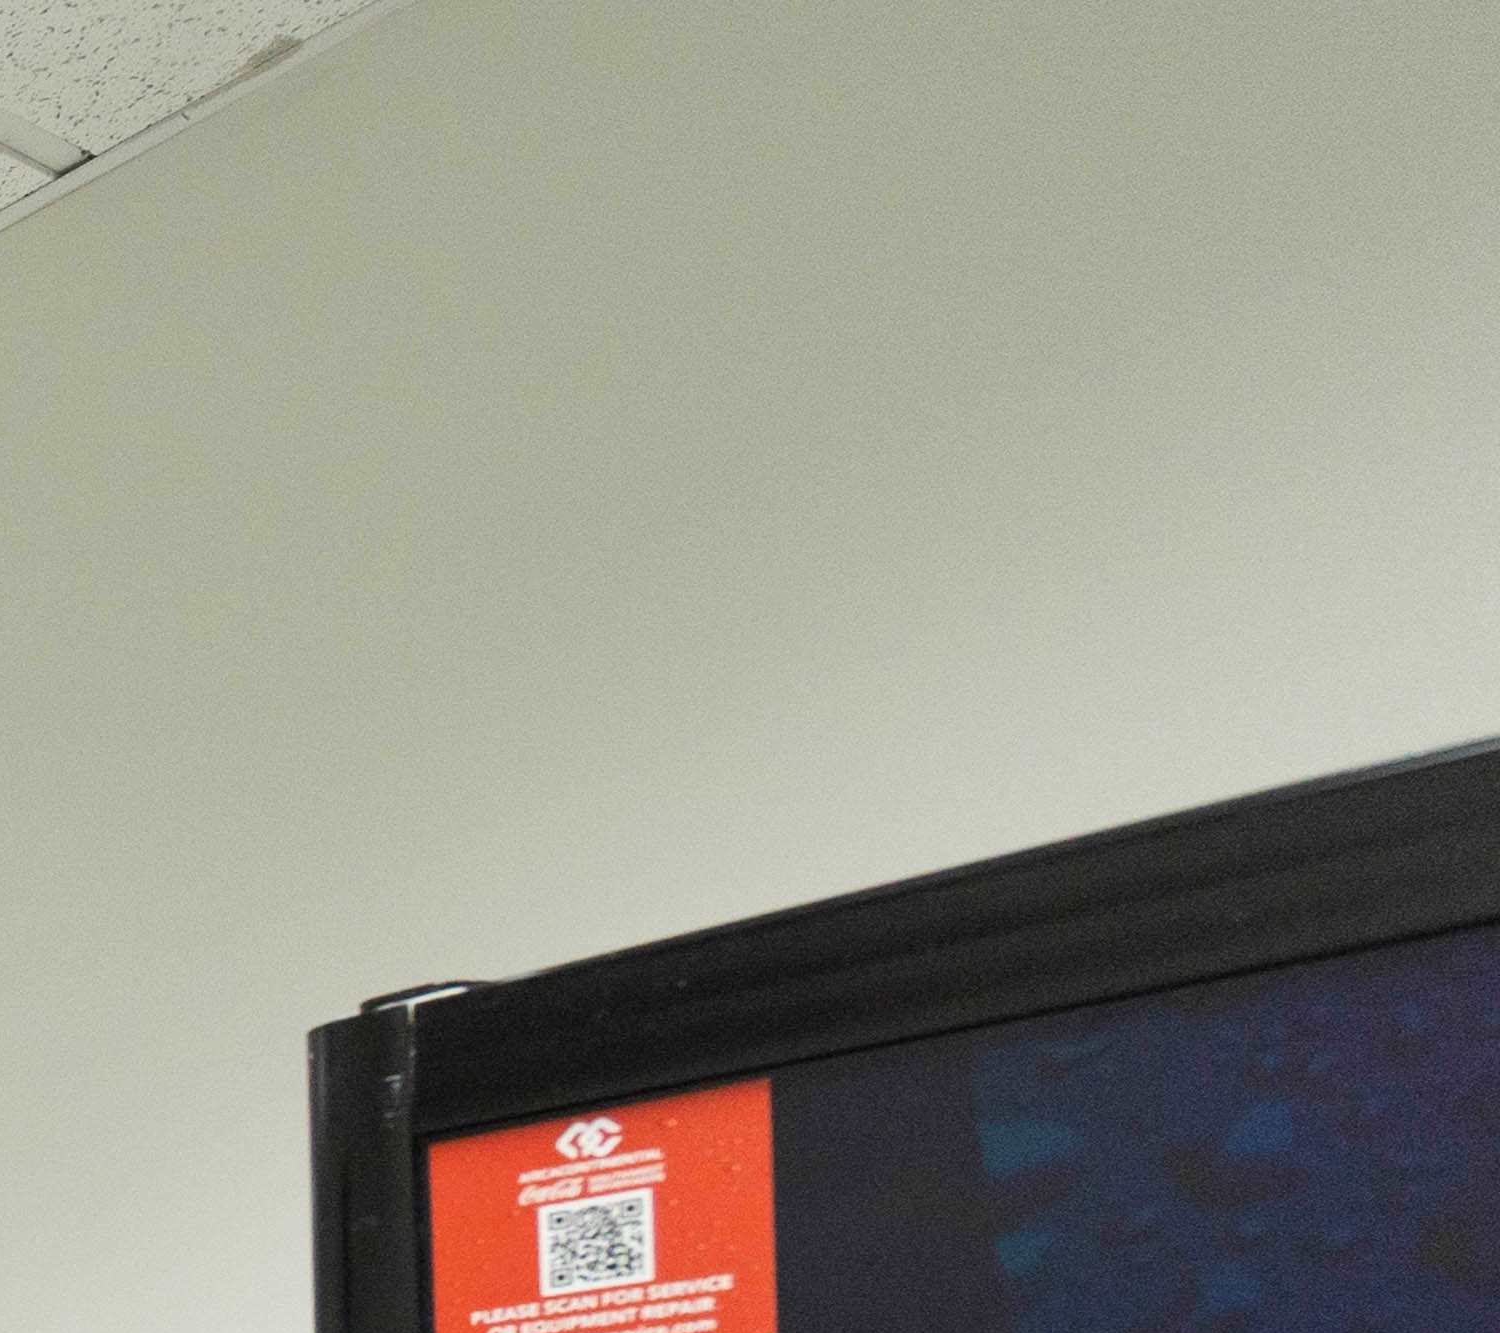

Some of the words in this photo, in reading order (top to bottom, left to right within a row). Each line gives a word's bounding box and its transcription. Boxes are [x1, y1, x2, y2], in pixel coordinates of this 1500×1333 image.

[470, 1302, 539, 1325] PLEASE
[544, 1293, 597, 1315] SCAN
[601, 1287, 642, 1306] FOR
[647, 1273, 733, 1300] SERVICE
[640, 1295, 715, 1320] REPAIR
